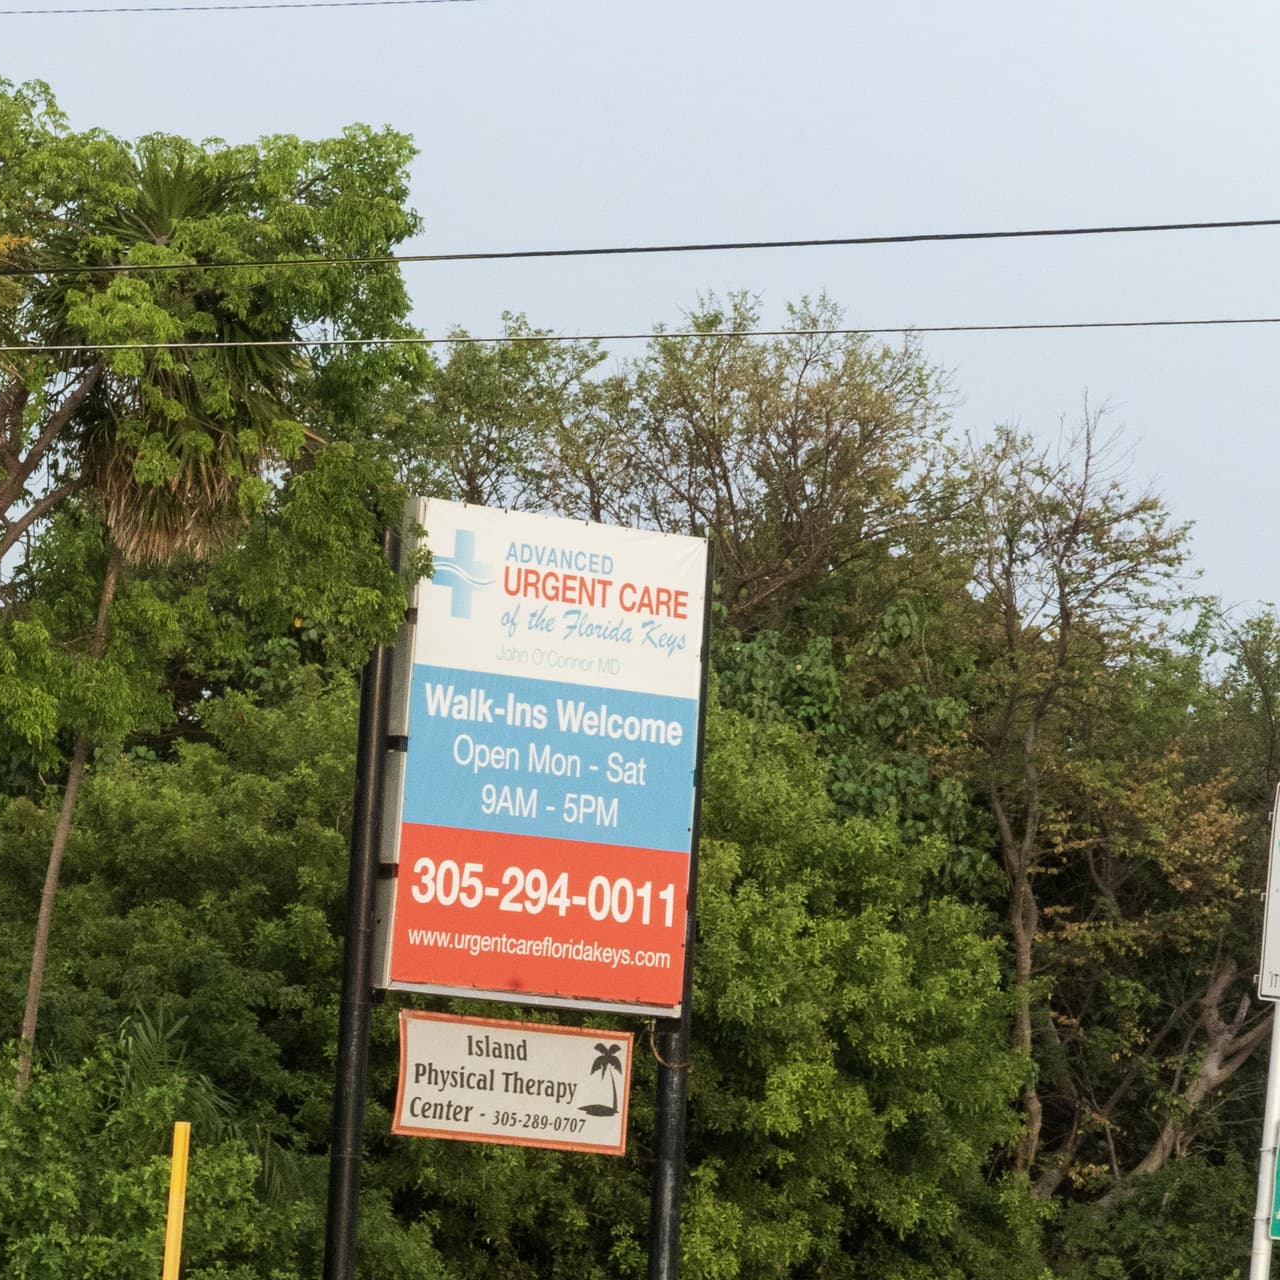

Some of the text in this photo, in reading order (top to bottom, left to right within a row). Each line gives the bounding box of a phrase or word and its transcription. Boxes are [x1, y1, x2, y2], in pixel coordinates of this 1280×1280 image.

[506, 542, 614, 575] ADVANCED
[503, 566, 689, 620] URGENT CARE
[500, 603, 688, 656] of the Florida Keys
[496, 644, 529, 664] John
[598, 656, 621, 676] MD
[424, 683, 683, 746] Walk-Ins Welcome
[453, 734, 519, 772] Open
[528, 743, 581, 778] Mon
[607, 752, 646, 786] Sat
[481, 784, 538, 818] 9AM
[563, 793, 618, 827] 5PM
[411, 857, 675, 928] 305-294-0011
[408, 928, 671, 969] www.urgentcarefloridakeys.com
[466, 1035, 528, 1061] Island
[414, 1063, 578, 1104] Physical Therapy
[409, 1096, 474, 1123] Center
[492, 1110, 587, 1135] 305-289-0707
